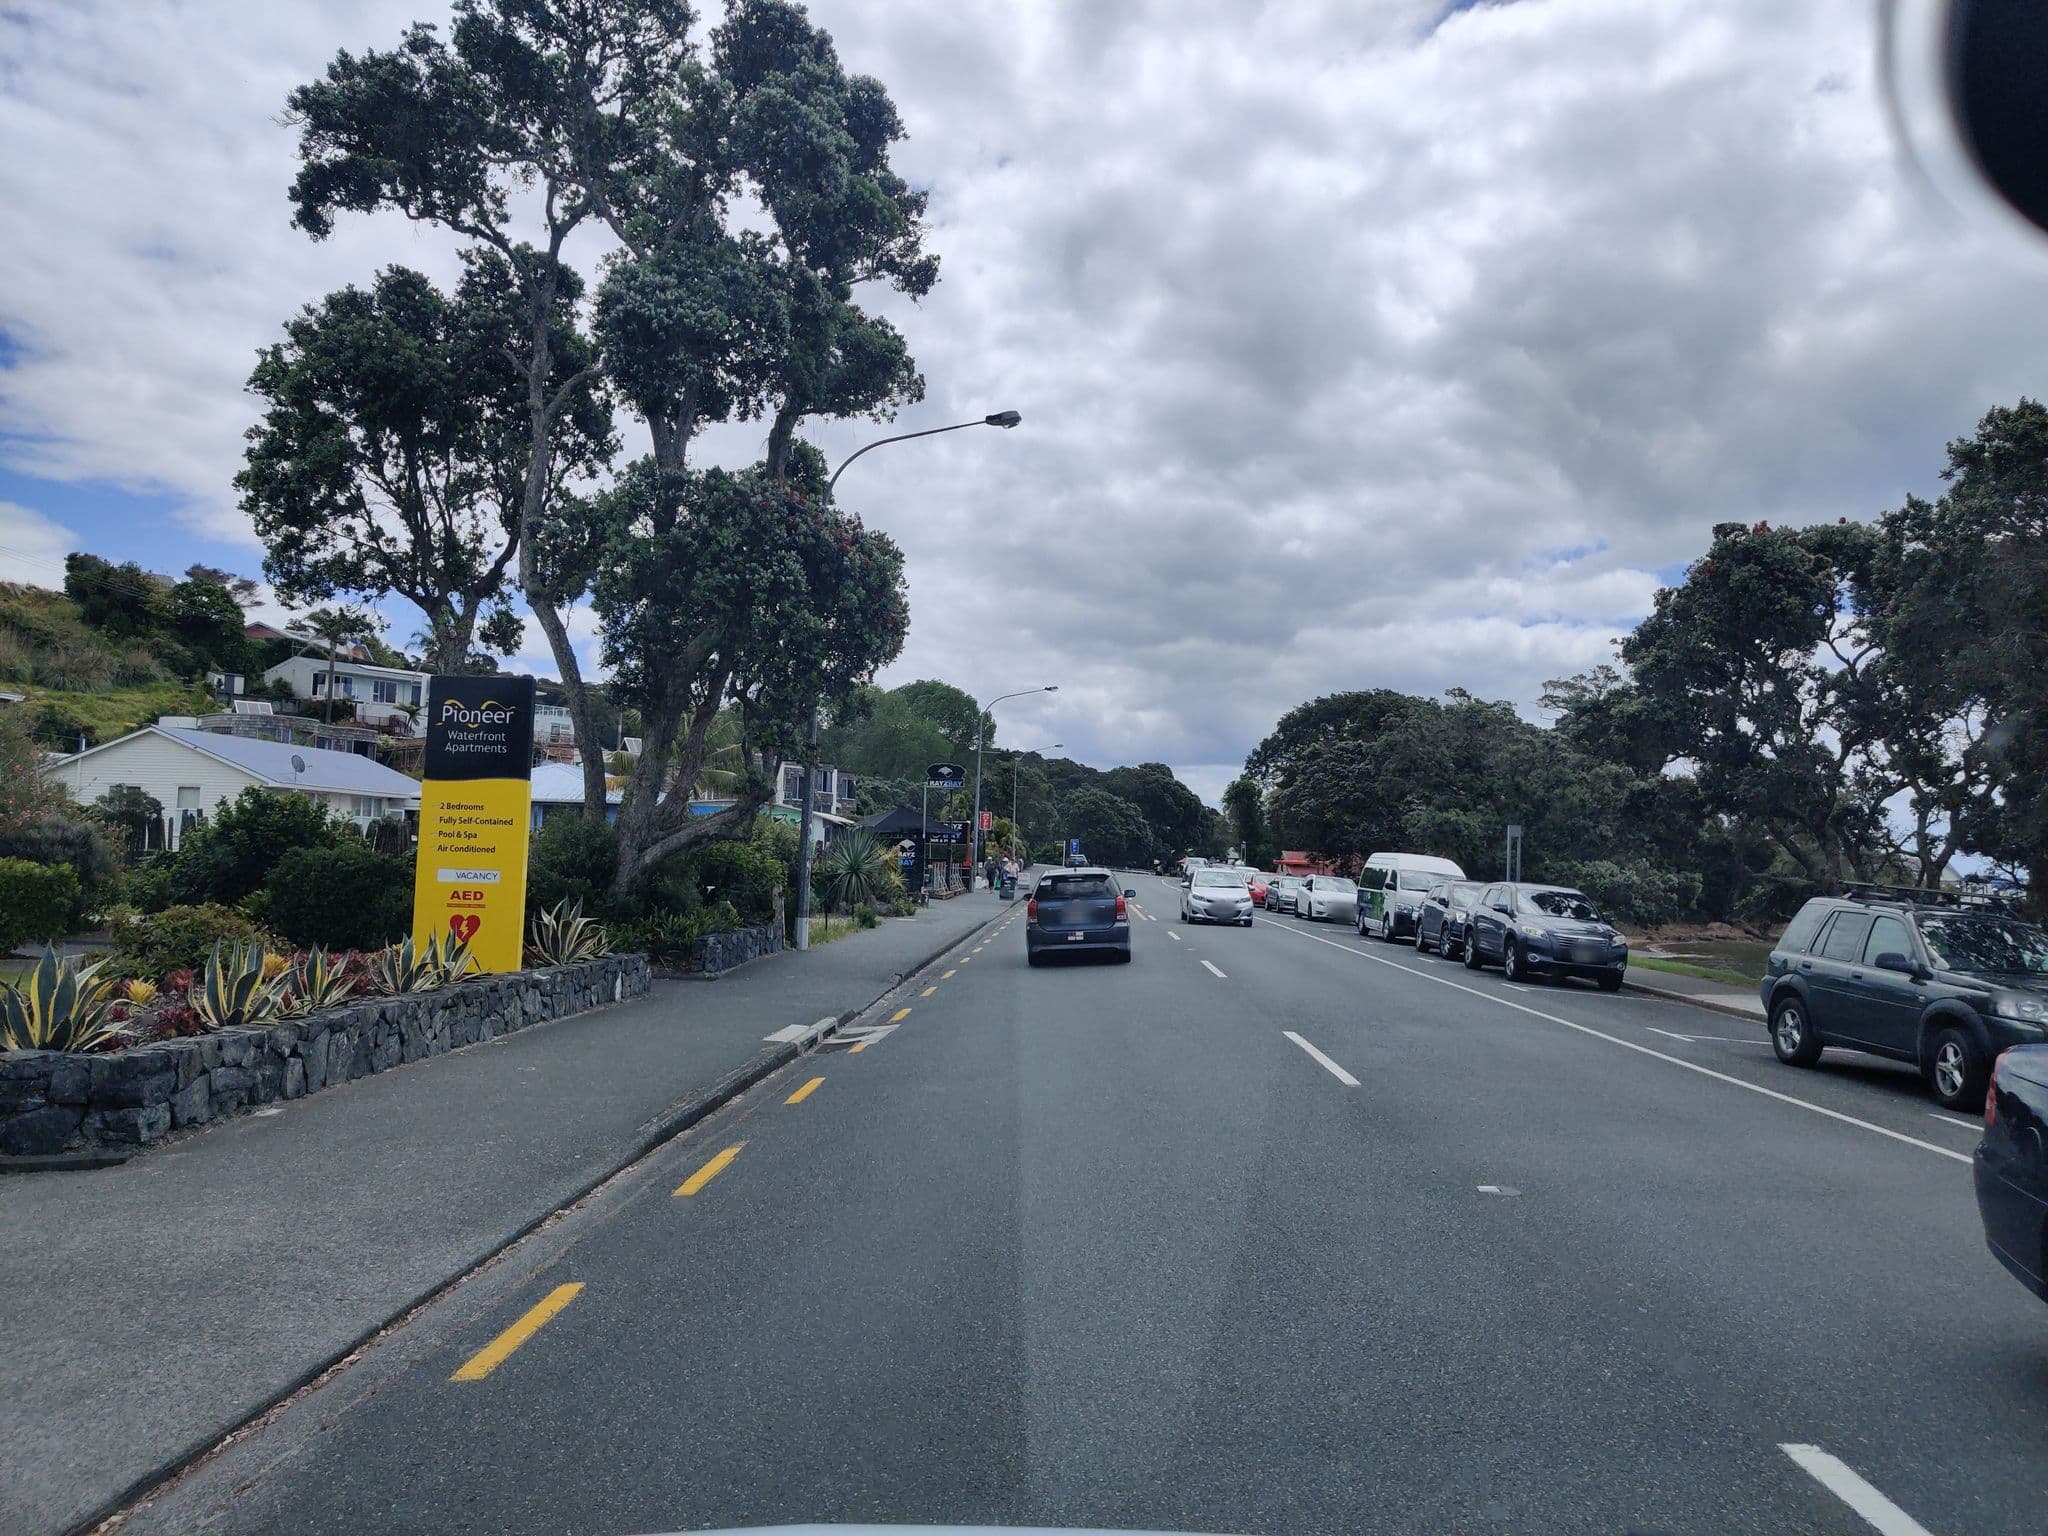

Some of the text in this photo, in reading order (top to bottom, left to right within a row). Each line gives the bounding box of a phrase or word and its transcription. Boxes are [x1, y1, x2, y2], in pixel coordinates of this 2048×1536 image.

[441, 705, 514, 724] Pioneer
[447, 730, 507, 742] Waterfront
[444, 742, 508, 755] Apartments
[439, 802, 484, 811] 2 Bedrooms
[439, 816, 514, 826] Fully Self-Contained
[438, 830, 478, 841] Pool & Spa
[437, 844, 496, 854] Air Conditioned
[455, 871, 498, 881] VACANCY
[450, 890, 484, 901] AED
